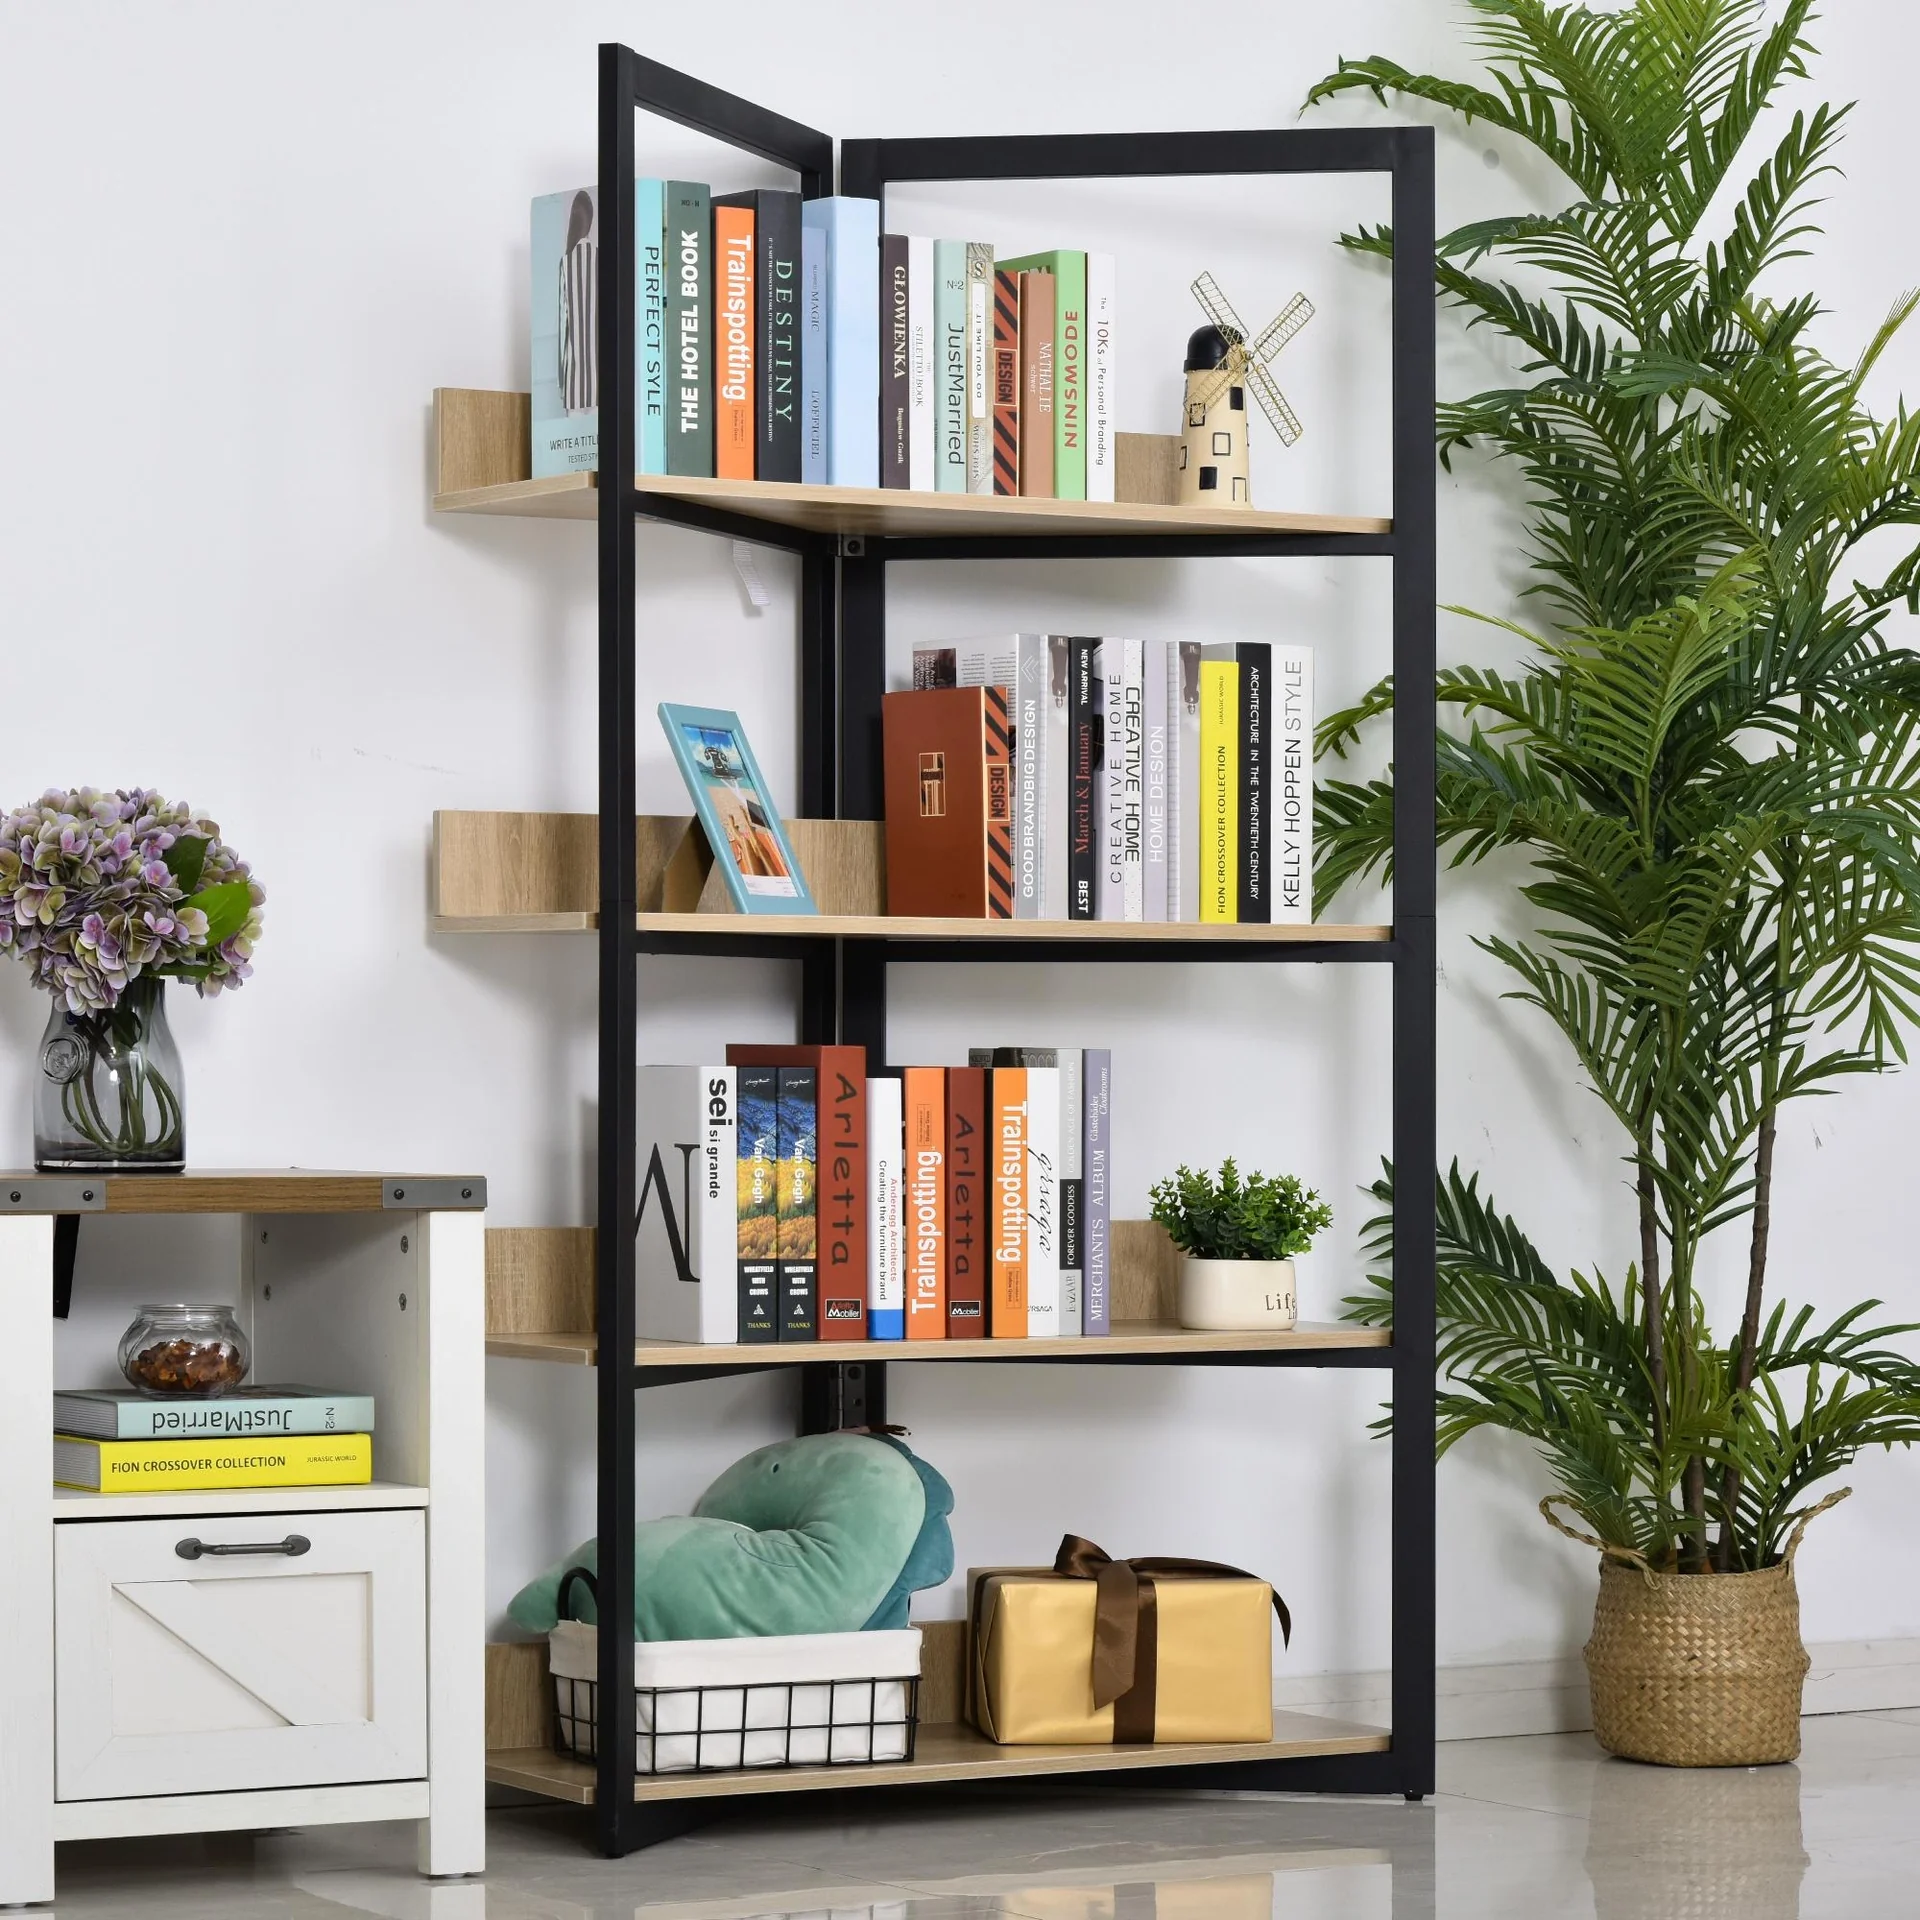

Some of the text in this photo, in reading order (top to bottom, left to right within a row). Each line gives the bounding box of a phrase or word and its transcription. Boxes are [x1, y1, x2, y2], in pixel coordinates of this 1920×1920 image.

[644, 245, 661, 416] PERFECT SYLE
[681, 230, 699, 433] THE HOTEL BOOK
[722, 234, 752, 401] Trainspotting
[775, 259, 793, 422] DESTINY
[811, 291, 820, 332] MAGIC
[975, 313, 982, 324] IT
[1097, 319, 1109, 355] 10Ks
[915, 326, 924, 407] STILETTO BOOK
[947, 322, 965, 465] JustMarried
[976, 382, 982, 399] DO
[997, 352, 1013, 403] DESIGN
[1039, 341, 1052, 413] NATHALIE
[1064, 310, 1078, 449] NINSMODE
[1097, 368, 1107, 415] Personal
[549, 435, 599, 451] WRITE A TITL
[568, 454, 588, 464] TESTED
[1096, 419, 1107, 467] Branding
[1080, 648, 1089, 705] NEW ARRIVAL
[1023, 699, 1037, 761] DESIGN
[990, 767, 1005, 818] DESIGN
[1075, 722, 1093, 854] March & January
[1109, 674, 1122, 884] CREATIVE HOME
[1125, 686, 1141, 863] CREATIVE HOME
[1250, 666, 1260, 900] ARCHITECTURE IN THE TWENTIETH CENTURY
[1284, 660, 1302, 908] KELLY HOPPEN STYLE
[1150, 809, 1164, 863] HOME
[1217, 745, 1226, 914] FION CROSSOVER COLLECTION
[1023, 849, 1037, 898] GOOD
[1078, 880, 1089, 913] BEST
[709, 1078, 732, 1126] sei
[1067, 1102, 1075, 1115] OF
[1099, 1067, 1108, 1115] Cloakrooms
[1067, 1117, 1075, 1134] AGE
[1067, 1136, 1076, 1173] GOLDEN
[706, 1146, 721, 1199] grande
[754, 1138, 766, 1204] Van Gogh
[794, 1138, 806, 1204] Van Gogh
[832, 1072, 858, 1266] Arletta
[955, 1113, 976, 1276] Arletta
[997, 1100, 1028, 1264] Trainspotting
[877, 1159, 887, 1301] Creating the furniture brand
[889, 1178, 898, 1282] Anderegg Architects
[911, 1150, 942, 1315] Trainspotting
[1067, 1184, 1076, 1265] FOREVER GODDESS
[1090, 1149, 1104, 1321] MERCHANTS ALBUM
[152, 1409, 293, 1434] JustMarried
[111, 1460, 140, 1473] FION
[143, 1458, 212, 1472] CROSSOVER
[215, 1455, 286, 1469] COLLECTION
[335, 1454, 357, 1462] WORLD
